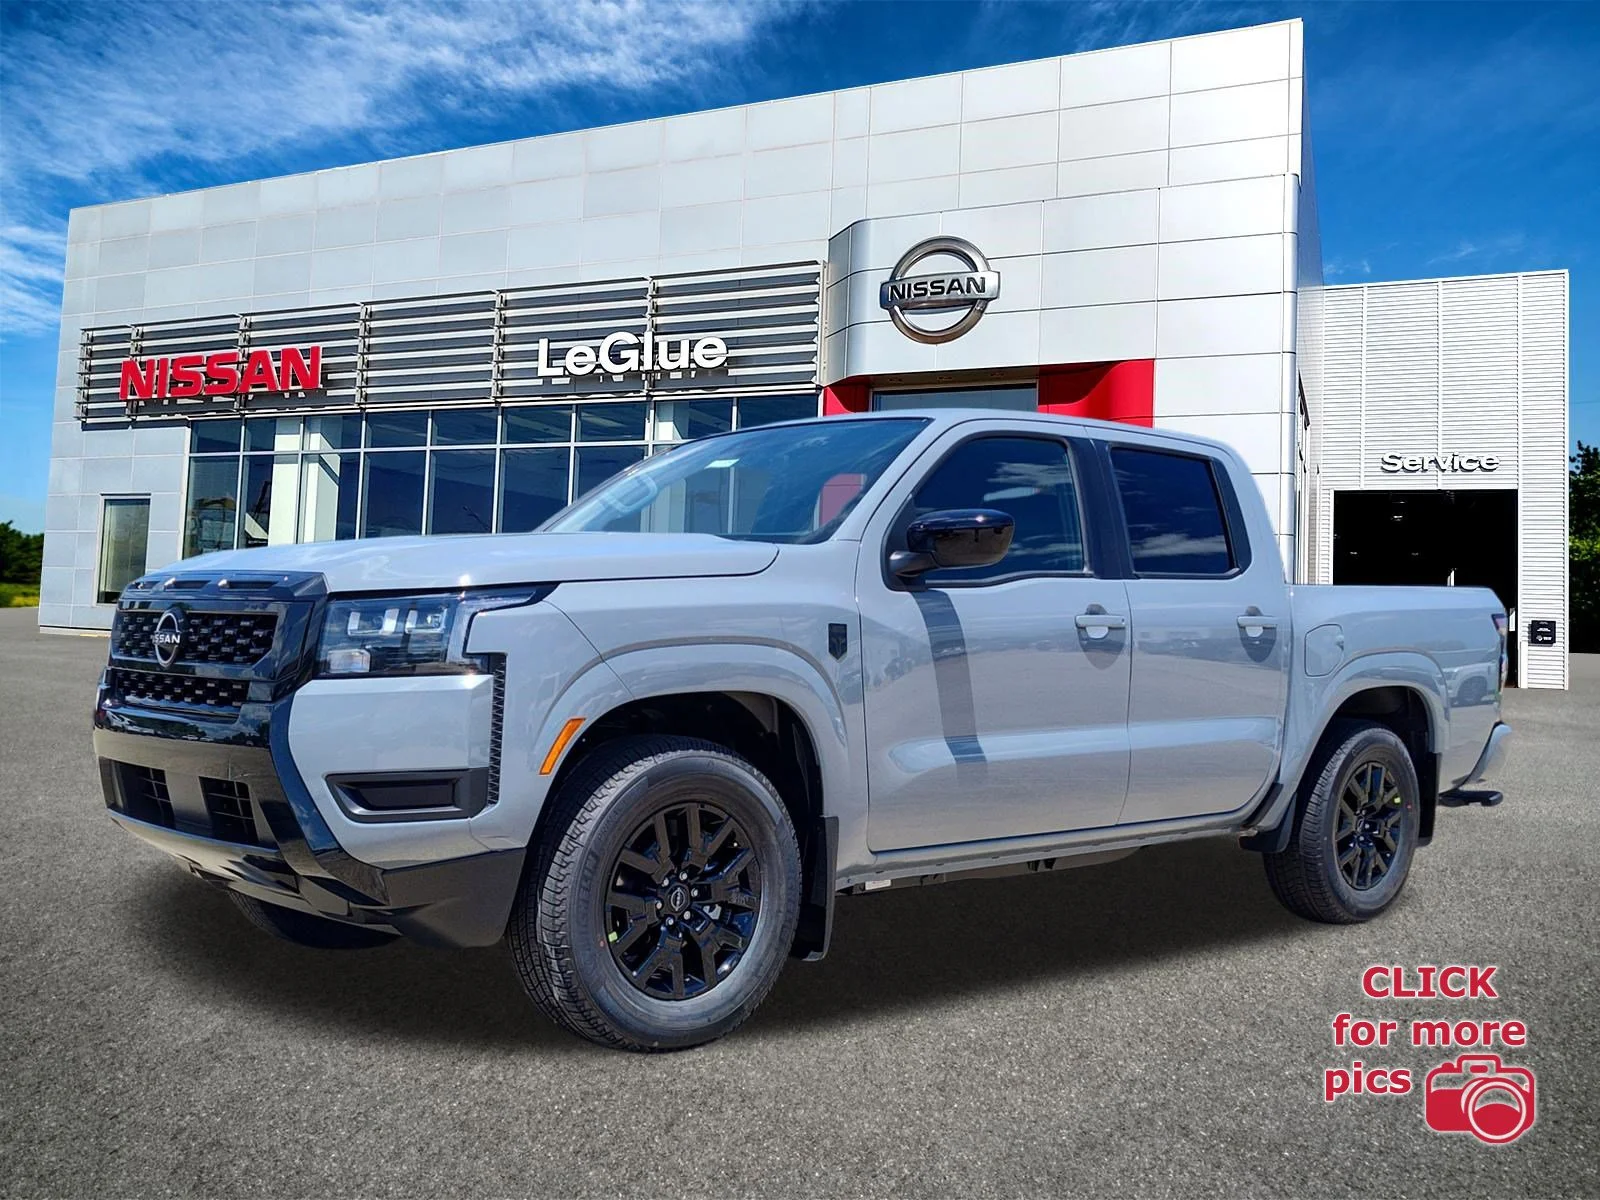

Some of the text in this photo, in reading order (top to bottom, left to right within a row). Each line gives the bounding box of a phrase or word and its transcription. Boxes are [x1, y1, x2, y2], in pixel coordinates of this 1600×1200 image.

[888, 277, 986, 302] NISSAN
[537, 331, 729, 377] LeGlue
[119, 345, 322, 400] NISSAN
[1381, 451, 1500, 472] Service
